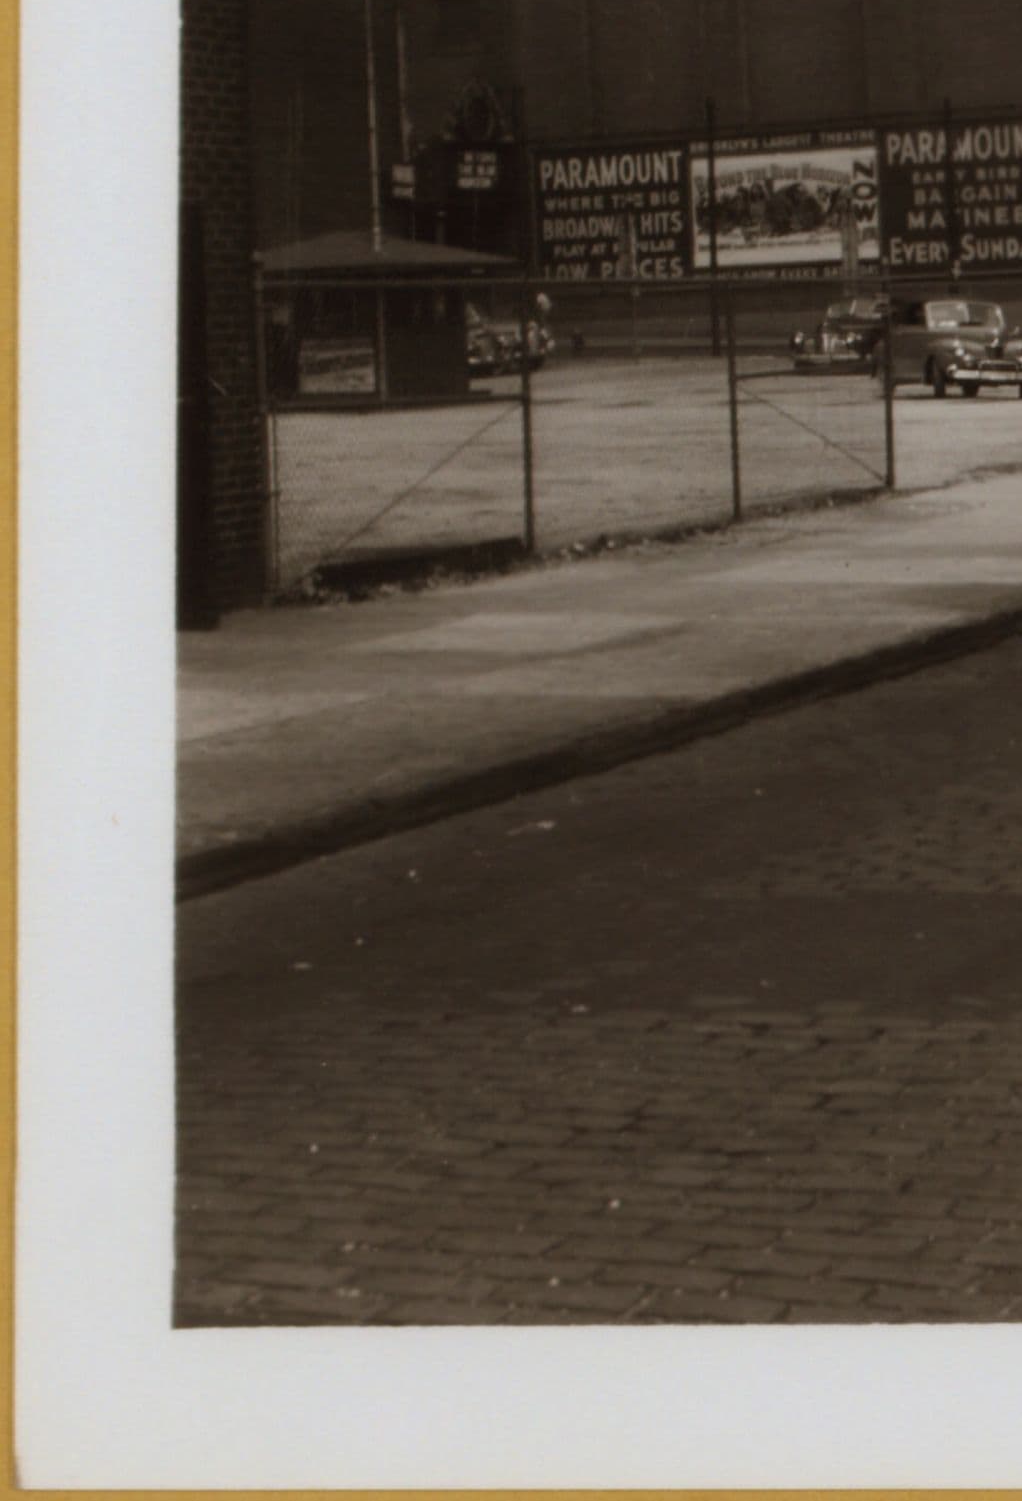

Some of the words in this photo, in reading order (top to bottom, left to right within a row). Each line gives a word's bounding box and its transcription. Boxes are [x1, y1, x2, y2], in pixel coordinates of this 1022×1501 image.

[541, 150, 683, 192] PARAMOUNT
[913, 167, 965, 186] EARY
[976, 164, 1021, 182] BIRD
[545, 194, 604, 213] WHERE
[649, 189, 680, 206] BIG
[854, 159, 877, 222] NOW
[914, 184, 1017, 206] BAGAIN
[543, 214, 637, 242] BROADWA
[641, 211, 683, 236] HITS
[554, 242, 586, 258] PLAY
[590, 241, 607, 257] AT
[612, 238, 676, 256] PULAR
[601, 257, 684, 281] PCES
